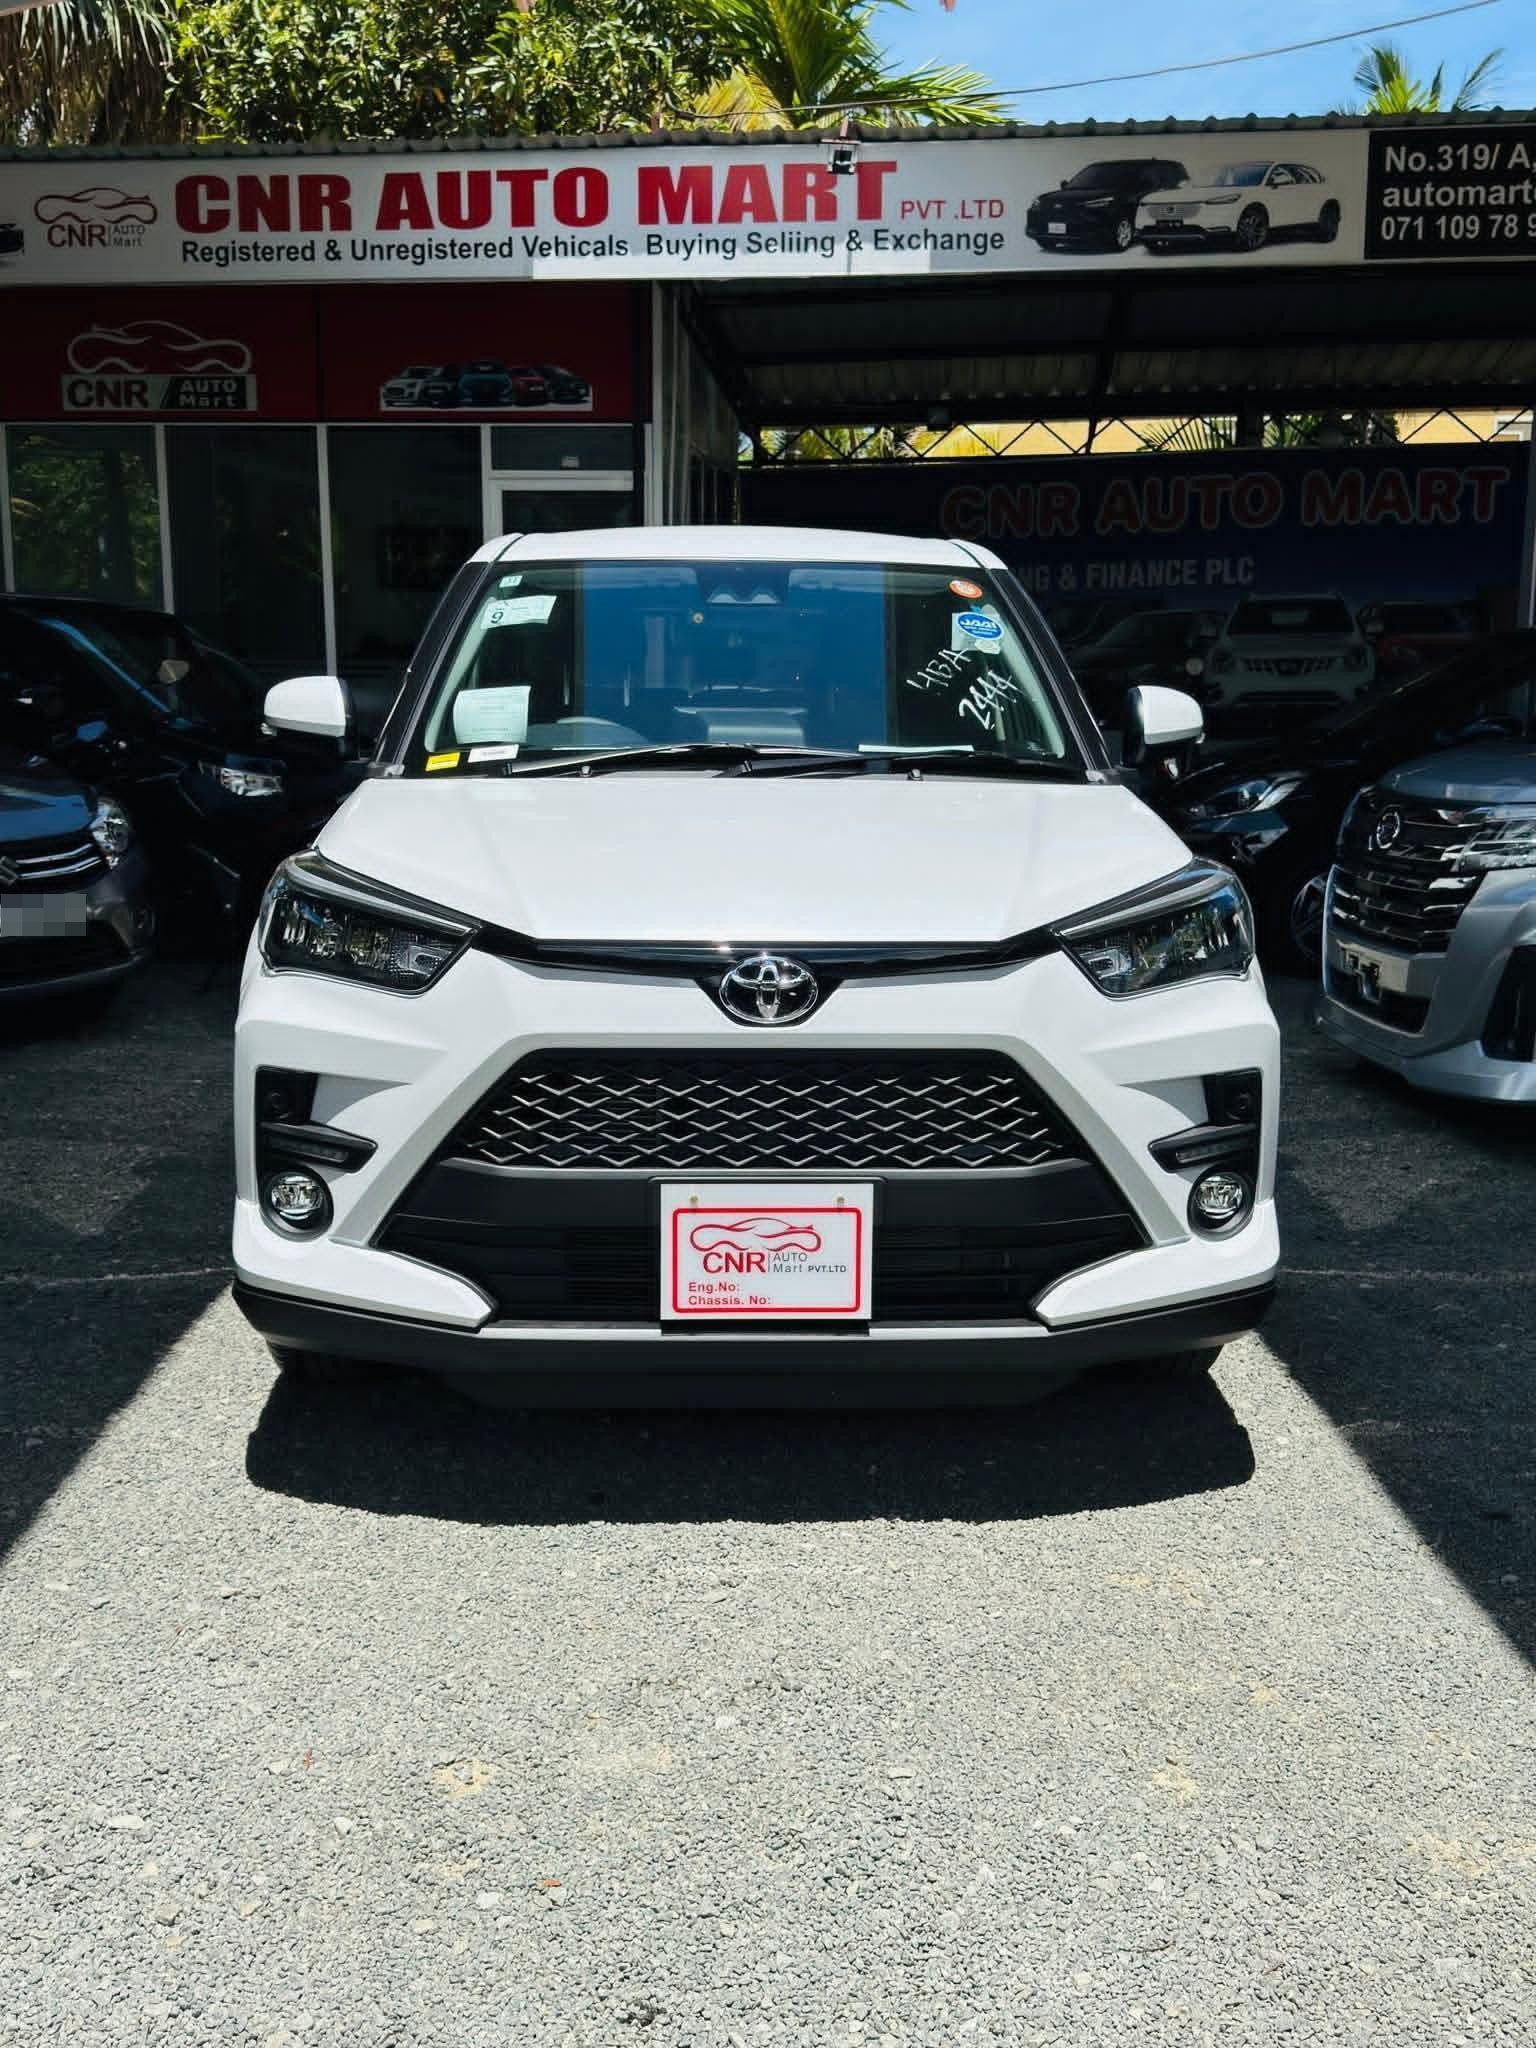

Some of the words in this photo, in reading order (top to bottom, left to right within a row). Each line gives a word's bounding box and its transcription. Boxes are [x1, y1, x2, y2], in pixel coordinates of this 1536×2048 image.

[1385, 143, 1501, 173] No.319/
[175, 173, 351, 234] CNR
[376, 167, 609, 230] AUTO
[638, 161, 898, 225] MART
[900, 200, 945, 219] PVT
[47, 223, 107, 248] CNR
[113, 224, 145, 235] AUTO
[1381, 215, 1424, 241] 071
[1435, 214, 1481, 240] 109
[1488, 213, 1519, 239] 78
[113, 236, 142, 248] Mart
[182, 240, 315, 267] Registered
[324, 239, 342, 262] &
[351, 236, 512, 266] Unregistered
[523, 234, 628, 258] Vehicals
[646, 232, 736, 260] Buying
[846, 229, 863, 252] &
[874, 228, 1005, 255] Exchange
[66, 380, 149, 408] CNR
[179, 379, 238, 393] AUTO
[179, 393, 238, 407] Mart
[942, 482, 1080, 539] CNR
[1095, 473, 1283, 534] AUTO
[1301, 466, 1509, 526] MART
[1058, 563, 1077, 592] &
[1085, 562, 1197, 589] FINANCE
[1204, 558, 1255, 585] PLC
[703, 1251, 767, 1274] CNR
[773, 1252, 808, 1262] AUTO
[773, 1263, 802, 1273] Mart
[808, 1265, 847, 1273] PVT.LTD
[688, 1281, 741, 1293] Eng.No:
[688, 1295, 745, 1305] Chassis.
[749, 1295, 771, 1305] No:
